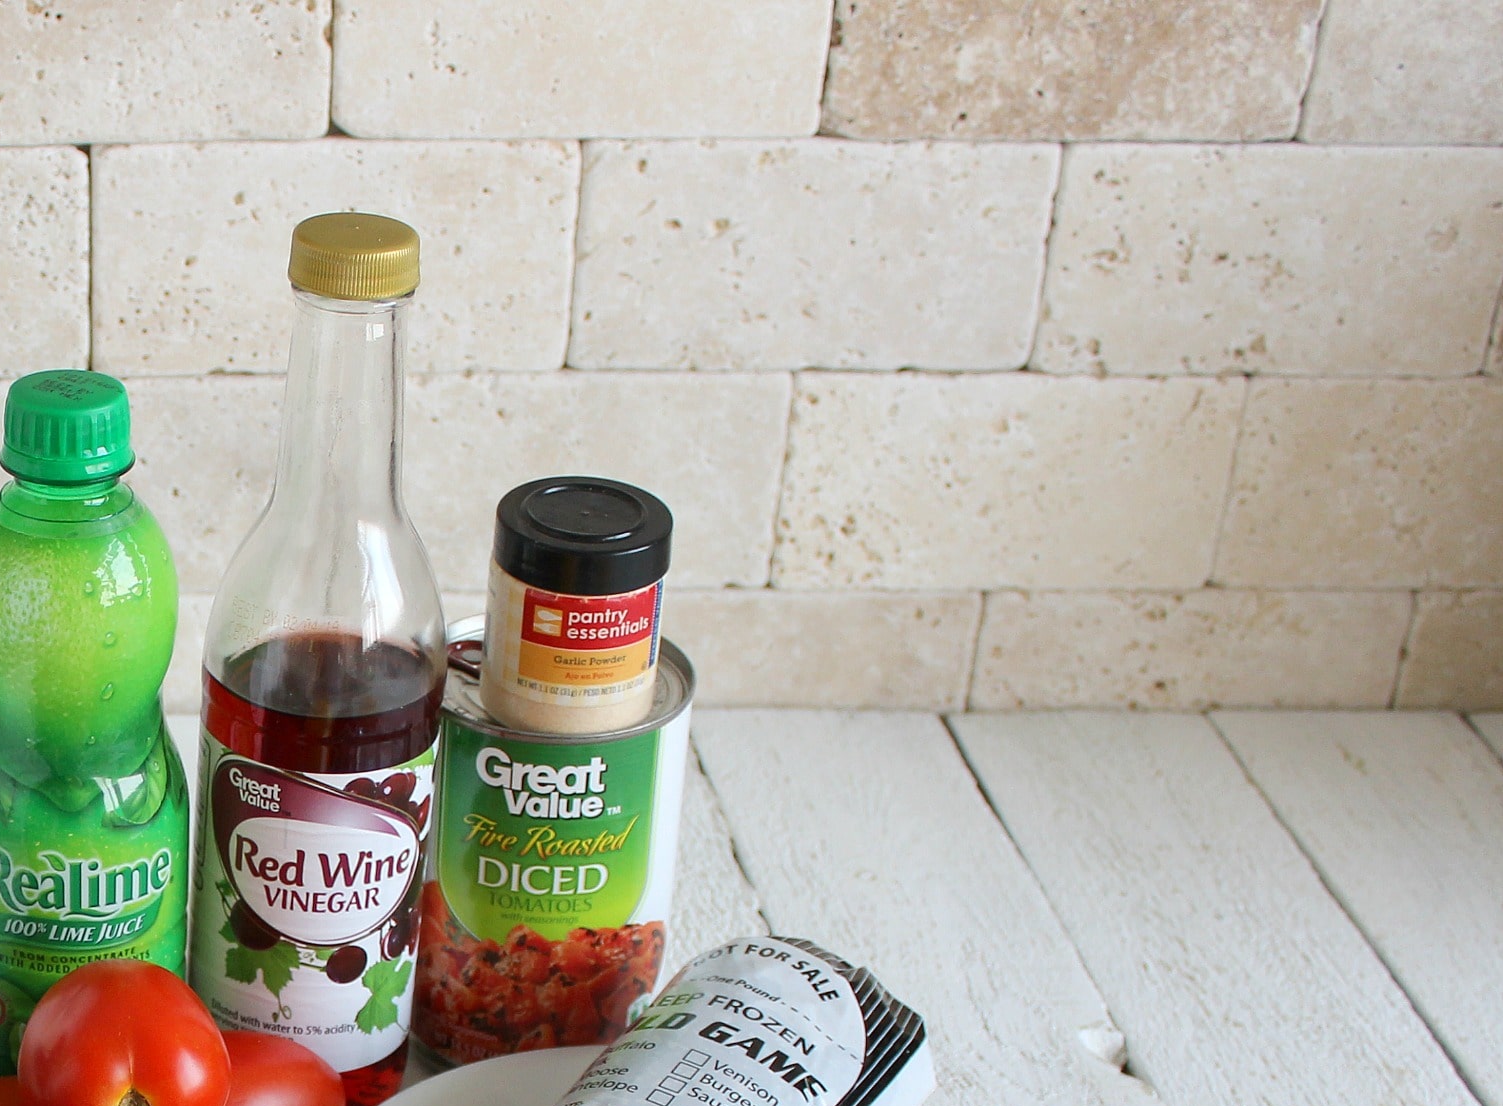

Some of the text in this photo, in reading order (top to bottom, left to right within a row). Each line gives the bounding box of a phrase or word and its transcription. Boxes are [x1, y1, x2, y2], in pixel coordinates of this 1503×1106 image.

[566, 616, 649, 640] essentials
[567, 608, 628, 627] pantry
[553, 655, 627, 666] Garlic Powder
[565, 672, 579, 681] Ajo
[476, 747, 607, 795] Great
[229, 767, 281, 802] Great
[239, 788, 280, 813] Value
[504, 789, 604, 819] Value
[463, 813, 640, 861] Fire Roasted
[235, 834, 410, 889] Red Wine
[477, 856, 609, 896] DICED
[263, 884, 380, 914] VINEGAR
[489, 891, 593, 913] TOMATOES
[4, 913, 146, 944] 100% LIME JUICE
[501, 911, 579, 925] with seasonings
[12, 949, 45, 962] FROM
[30, 963, 71, 974] ADDED
[745, 944, 792, 962] FOR
[791, 960, 840, 1002] SALE
[707, 975, 781, 1003] One Pound
[240, 1015, 260, 1028] with
[262, 1021, 292, 1035] water
[293, 1026, 304, 1035] to
[305, 1025, 322, 1036] 5%
[324, 1023, 356, 1037] acidity
[649, 992, 815, 1056] EEP FROZEN
[584, 1067, 629, 1078] oose
[698, 1021, 827, 1103] GAME
[576, 1079, 638, 1094] ntelope
